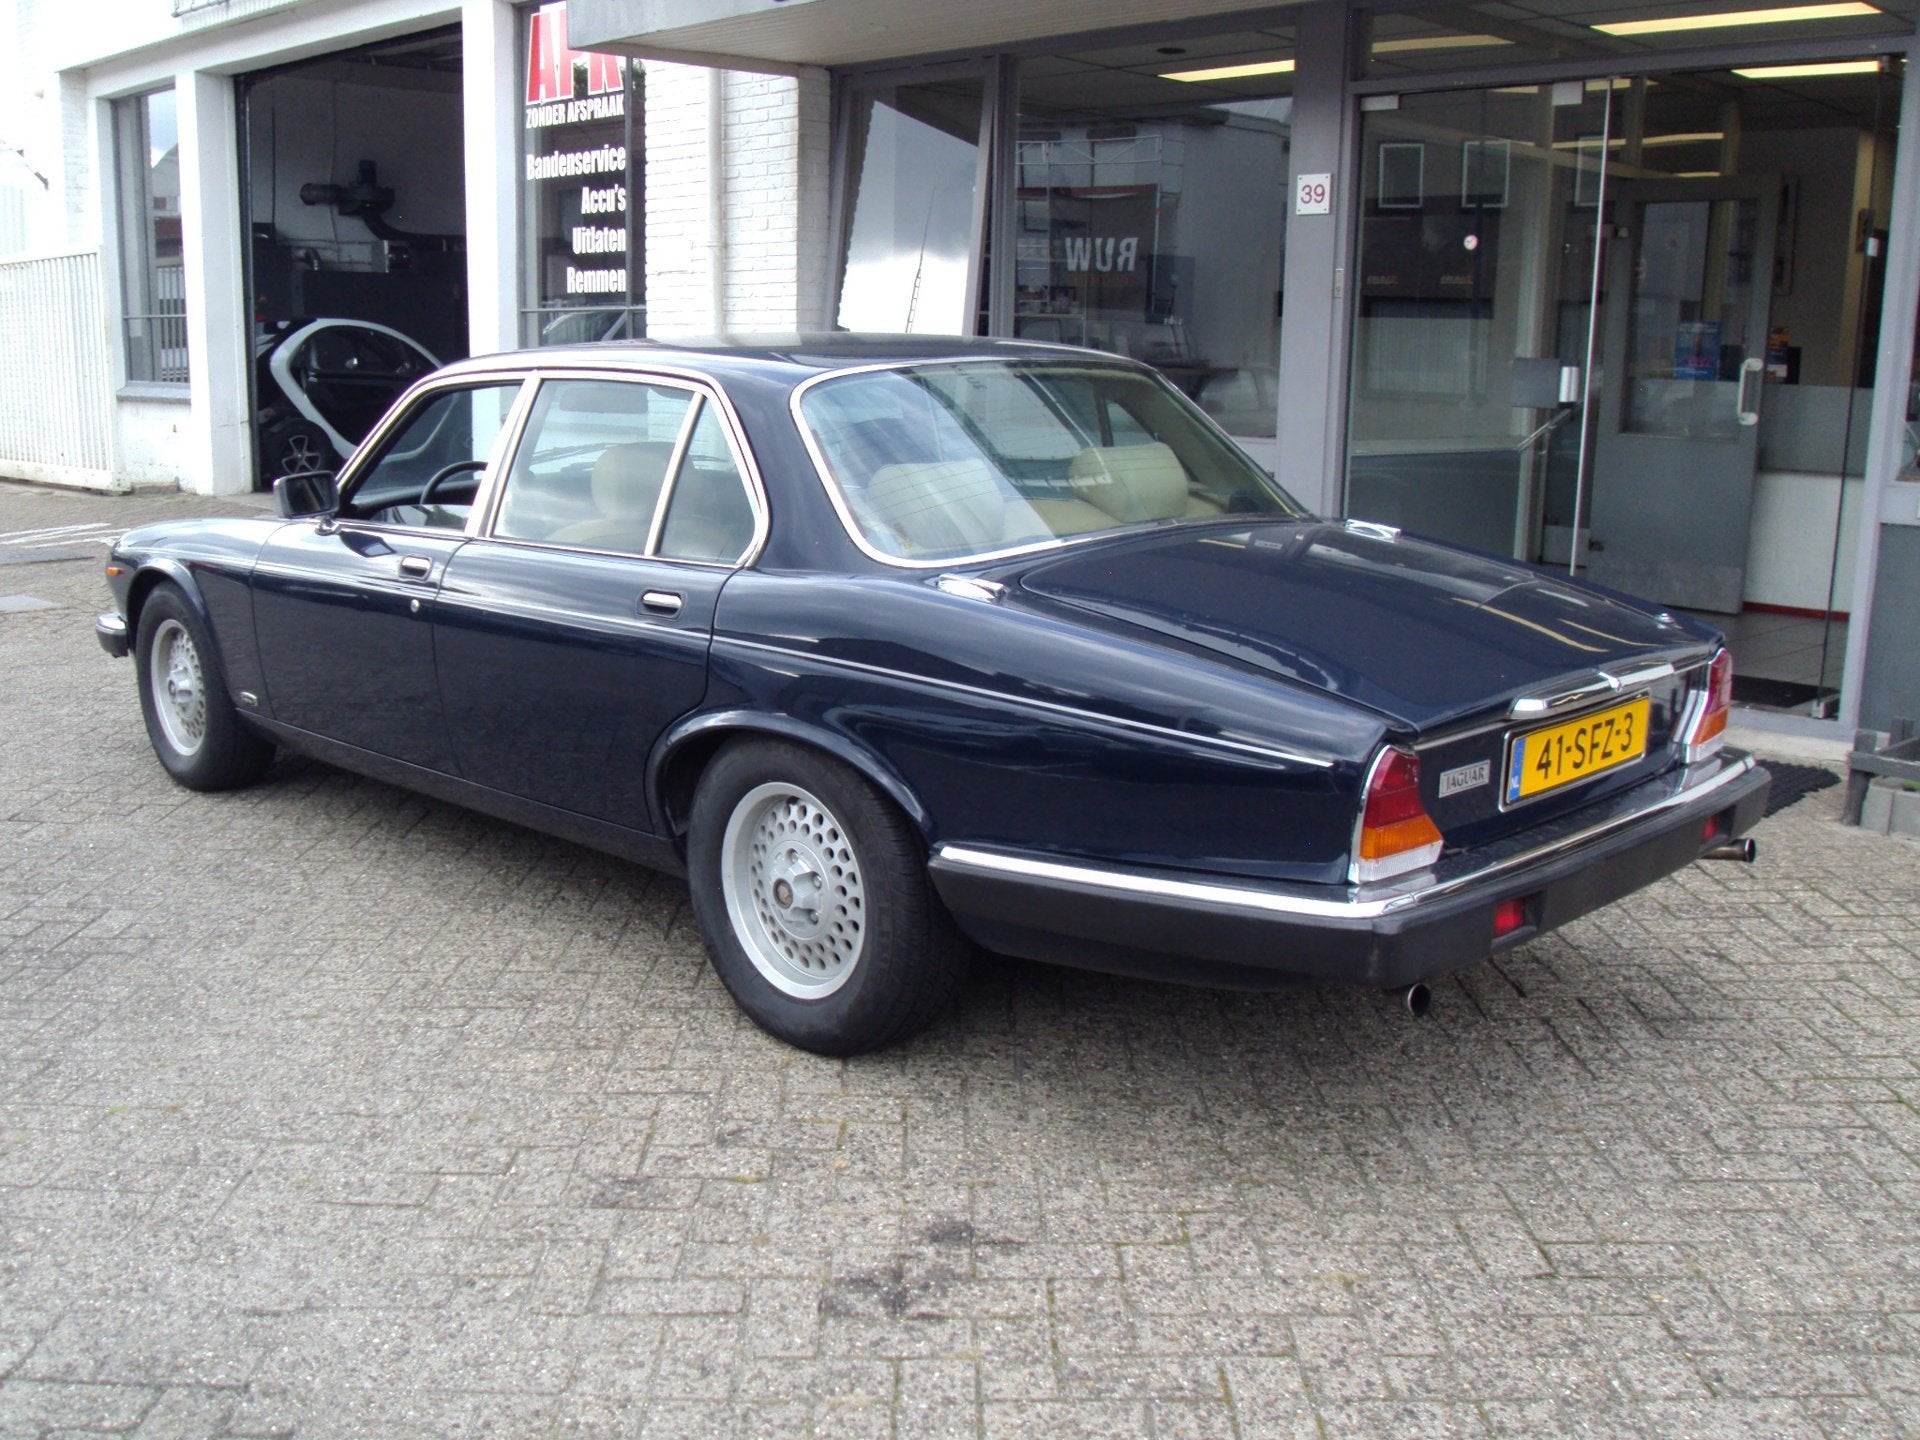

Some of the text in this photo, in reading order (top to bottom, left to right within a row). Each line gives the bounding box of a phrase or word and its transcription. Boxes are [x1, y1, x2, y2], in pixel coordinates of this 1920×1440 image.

[526, 93, 625, 129] ZONDER AFSPRAAK
[526, 144, 626, 180] Bandenservice
[581, 184, 626, 214] Accu's
[1300, 184, 1326, 205] 39
[572, 226, 626, 254] Uitlaten
[566, 266, 626, 293] Remmen
[1536, 712, 1633, 780] 41-SFZ-3
